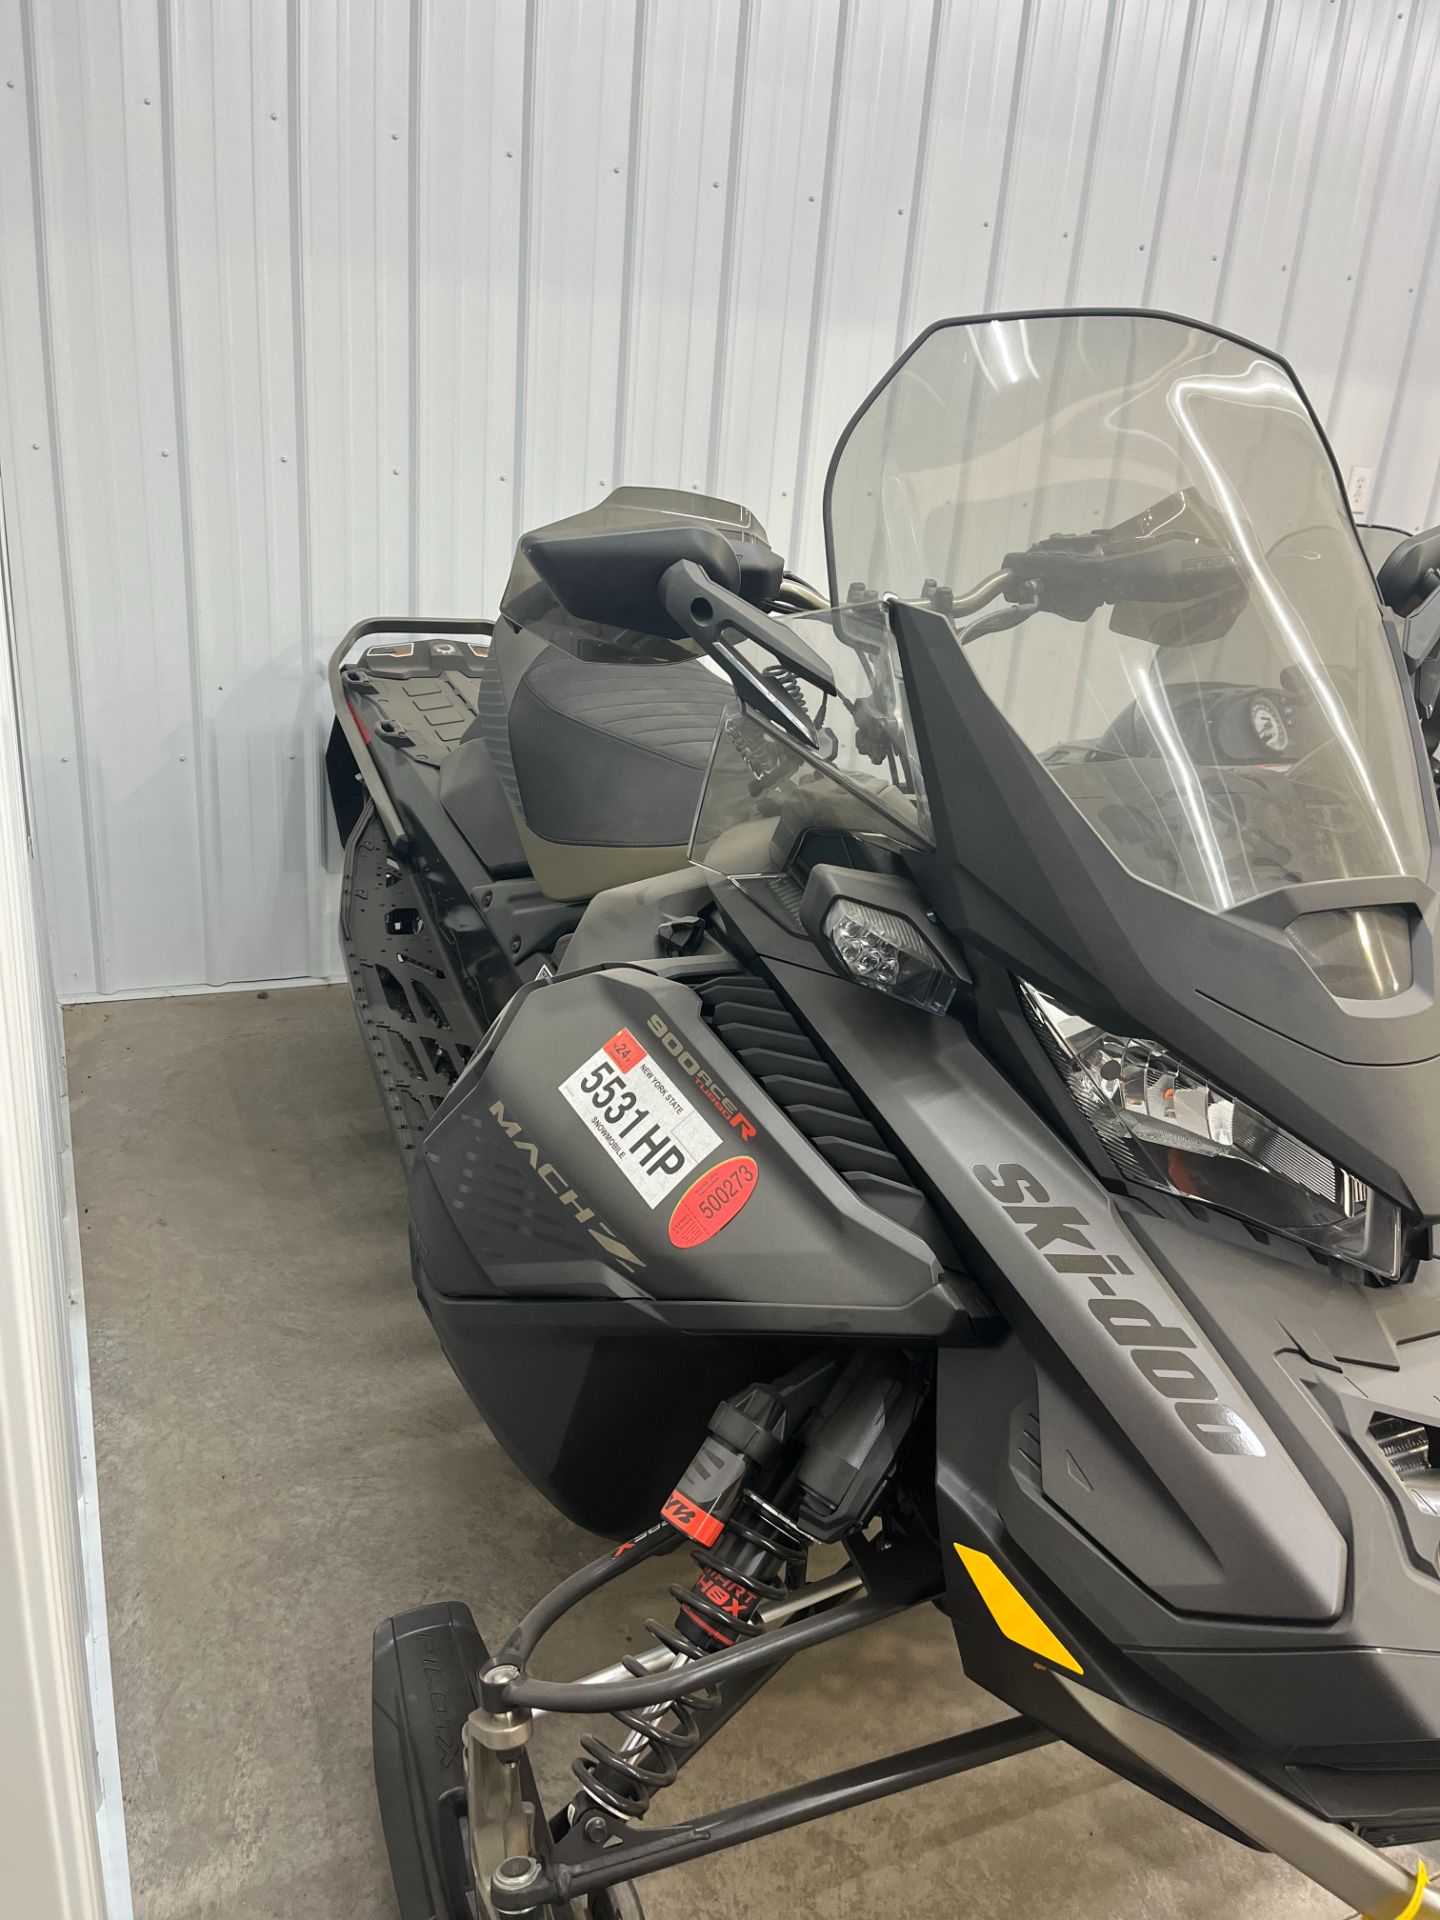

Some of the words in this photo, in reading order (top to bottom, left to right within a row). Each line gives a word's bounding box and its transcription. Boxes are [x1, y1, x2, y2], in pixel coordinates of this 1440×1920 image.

[616, 1043, 631, 1059] 24
[647, 1013, 700, 1076] 900
[640, 1064, 654, 1079] NEW
[652, 1077, 667, 1097] YORK
[665, 1092, 684, 1115] STATE
[489, 1100, 596, 1224] MACH
[591, 1116, 627, 1160] SNOWMOBILE
[698, 1165, 754, 1220] 500273
